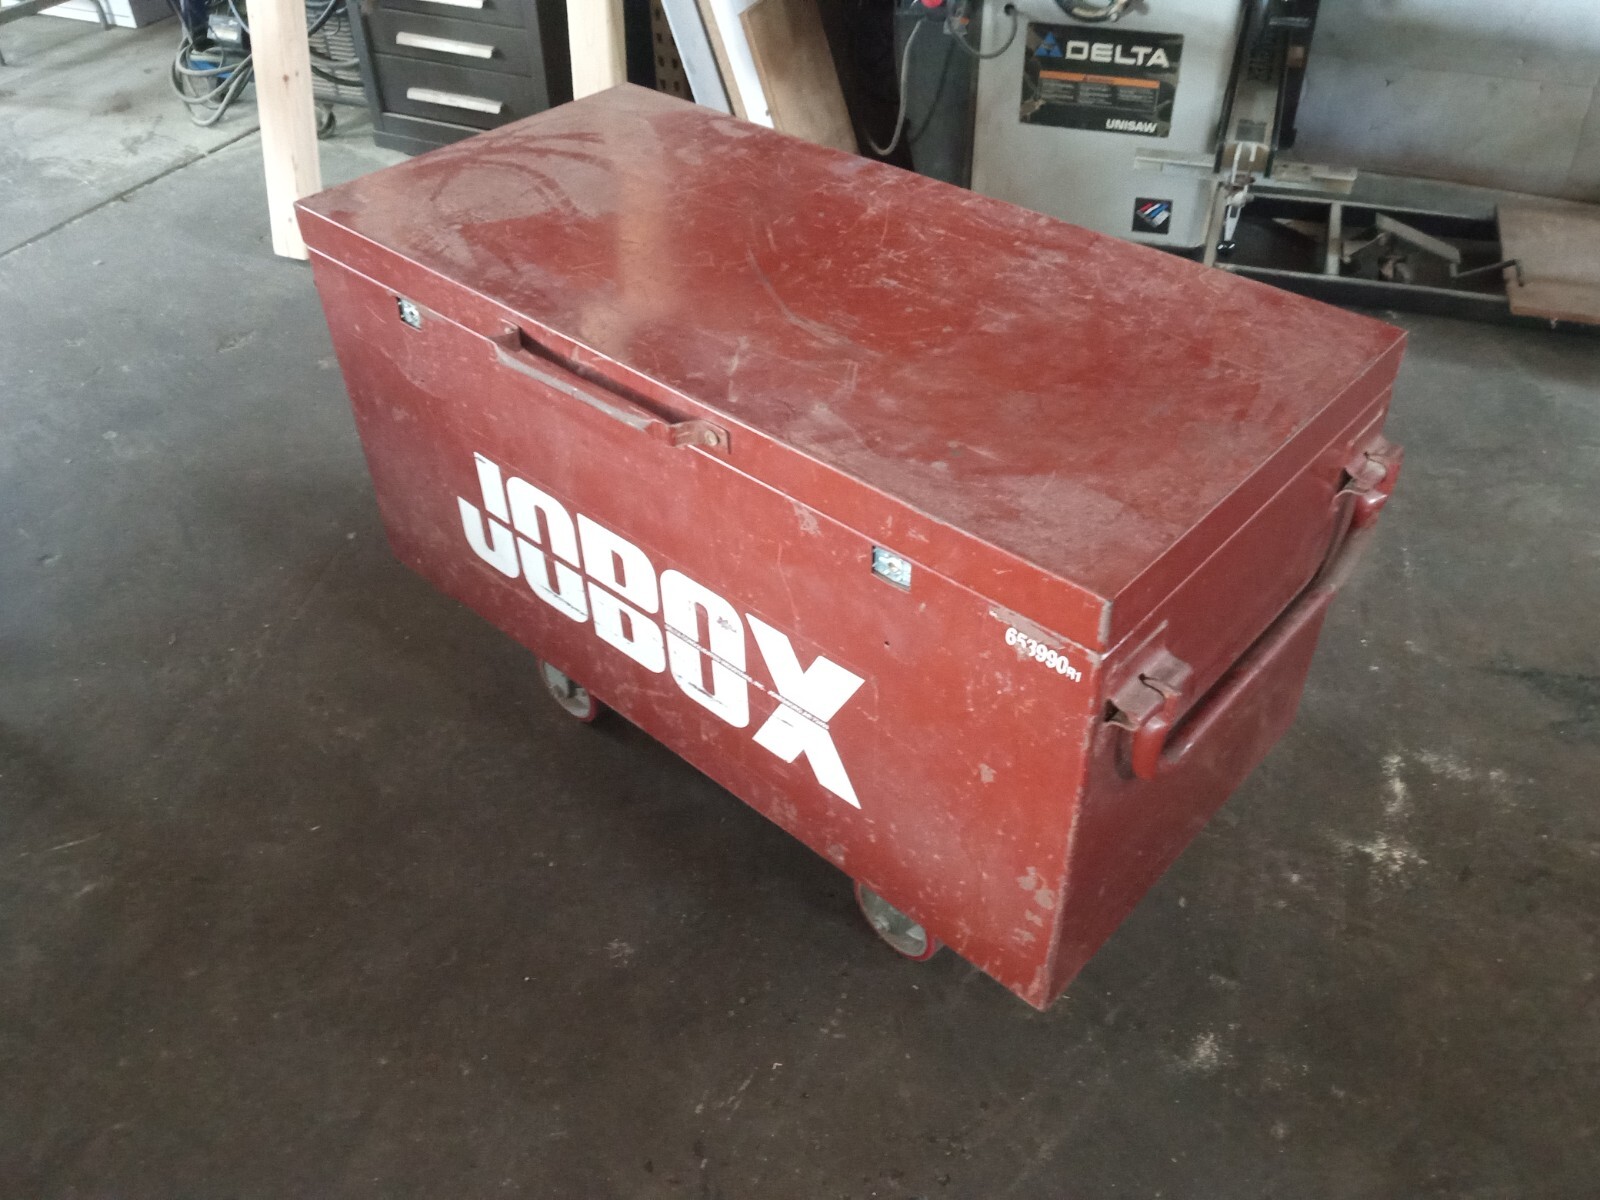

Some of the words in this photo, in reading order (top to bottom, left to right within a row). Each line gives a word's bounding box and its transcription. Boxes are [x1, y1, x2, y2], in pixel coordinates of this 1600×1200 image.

[1065, 40, 1170, 69] DELTA
[1105, 118, 1157, 133] UNISAW
[457, 451, 866, 809] JOBOX
